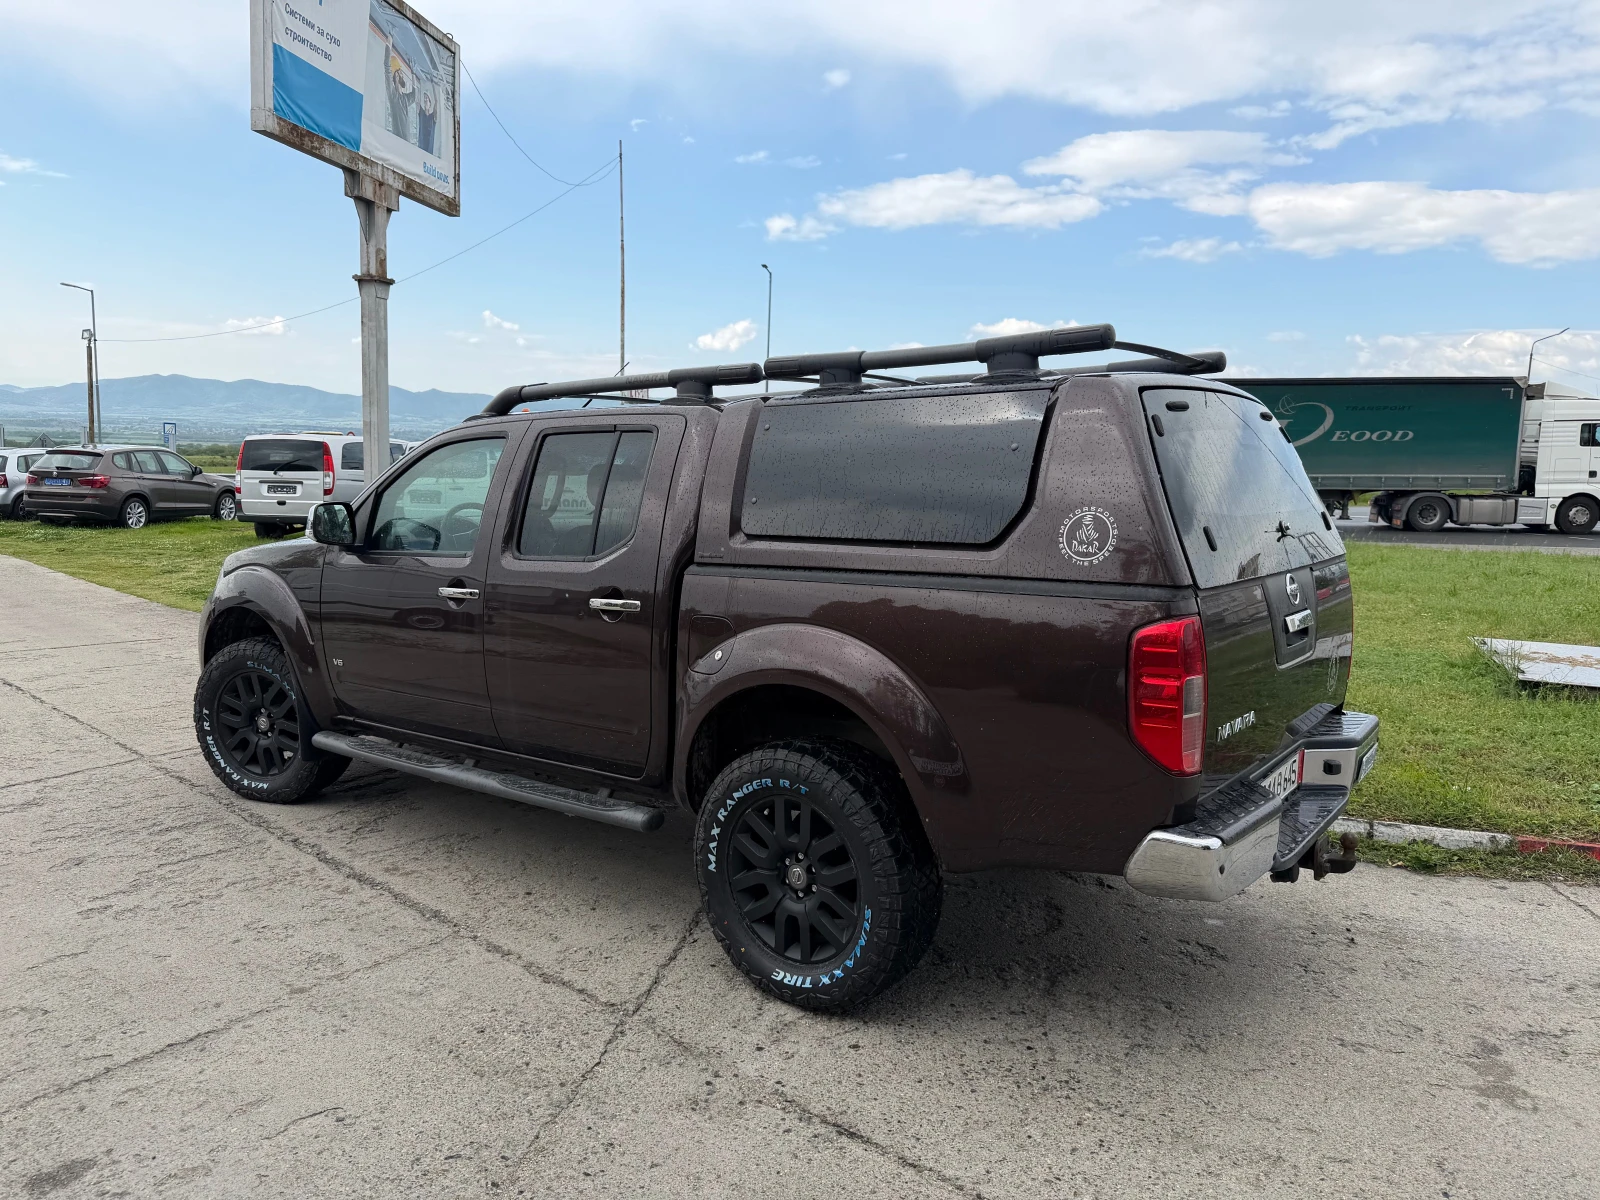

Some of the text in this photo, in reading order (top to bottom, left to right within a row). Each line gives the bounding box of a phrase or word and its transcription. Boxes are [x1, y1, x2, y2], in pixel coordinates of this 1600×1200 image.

[284, 2, 341, 47] Системи за сухо
[284, 26, 333, 62] строителство
[1329, 430, 1415, 442] EOOD
[332, 658, 344, 667] V6
[1217, 710, 1255, 742] NAVARA
[206, 735, 241, 781] RANGER
[240, 779, 270, 790] MAX
[707, 778, 810, 873] MAX RANGER R/T
[770, 968, 813, 988] TIRE
